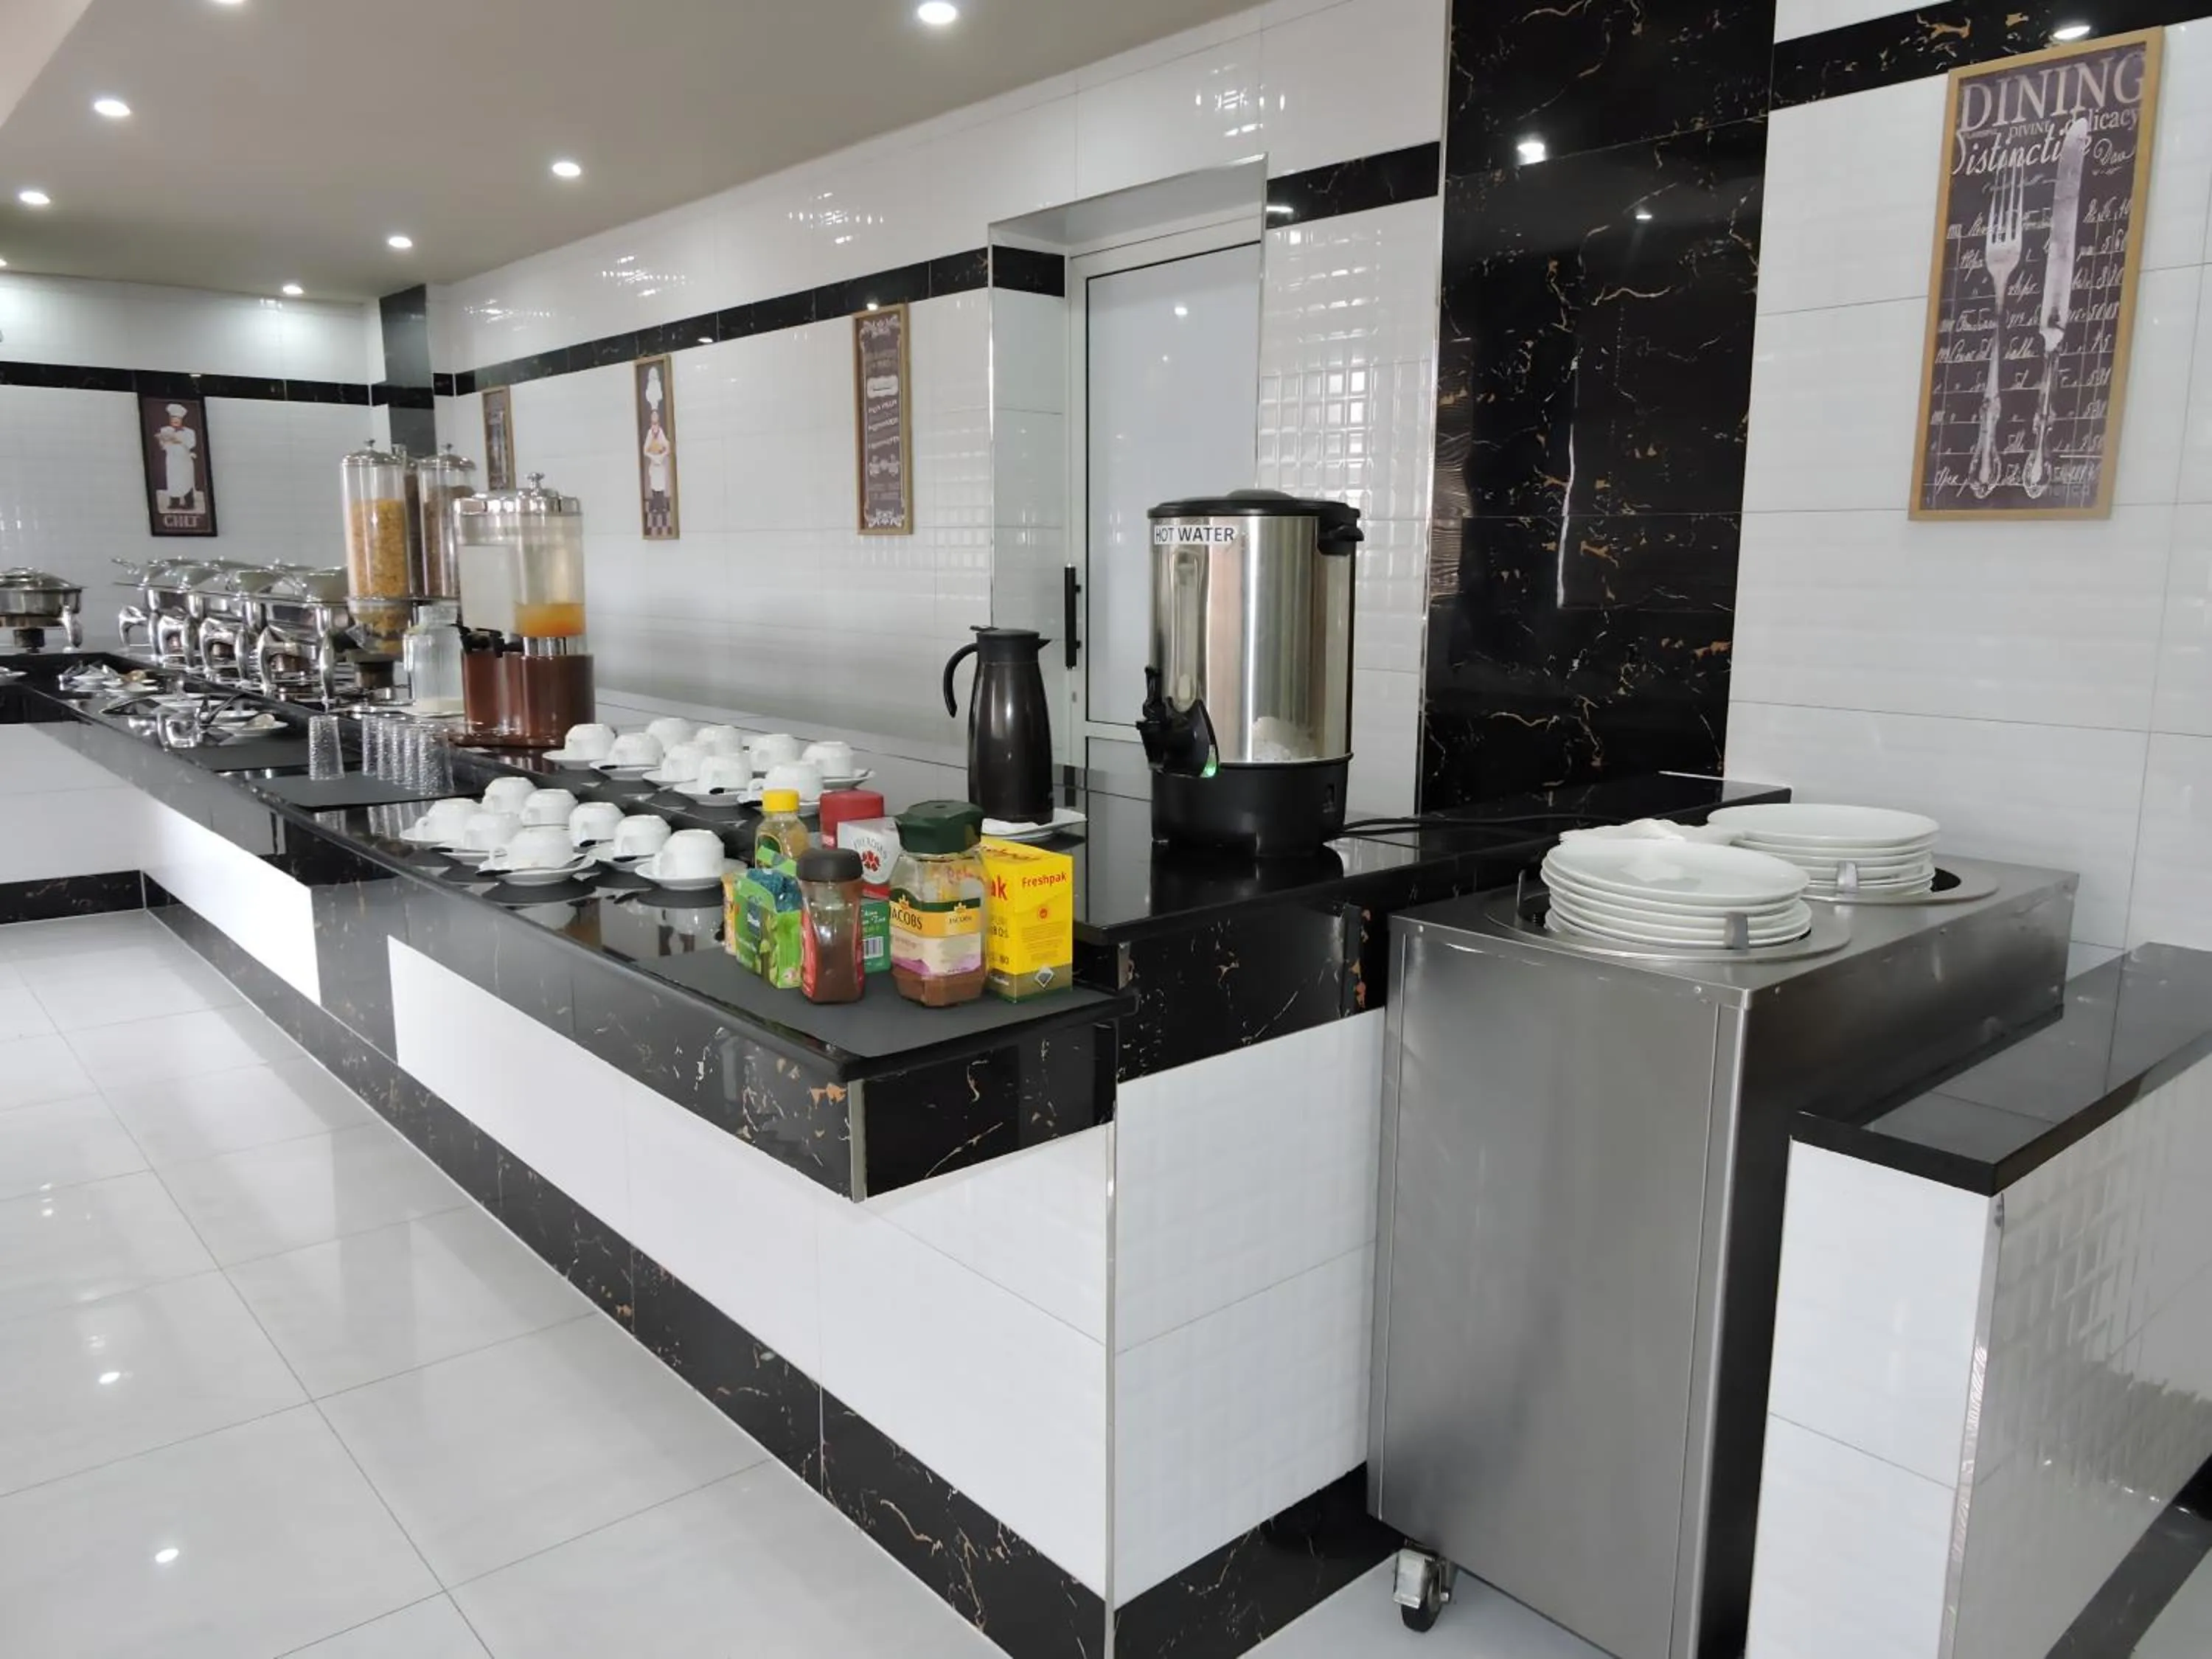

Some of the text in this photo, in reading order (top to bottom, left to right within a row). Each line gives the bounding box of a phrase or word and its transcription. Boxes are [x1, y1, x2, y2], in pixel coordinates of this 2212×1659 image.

[1960, 51, 2145, 133] DINING
[2065, 108, 2138, 134] dlicacy
[1952, 124, 2093, 175] istinctie
[1155, 527, 1234, 542] HOT WATER
[1022, 872, 1067, 888] Freshpak
[890, 908, 922, 930] ACOBS
